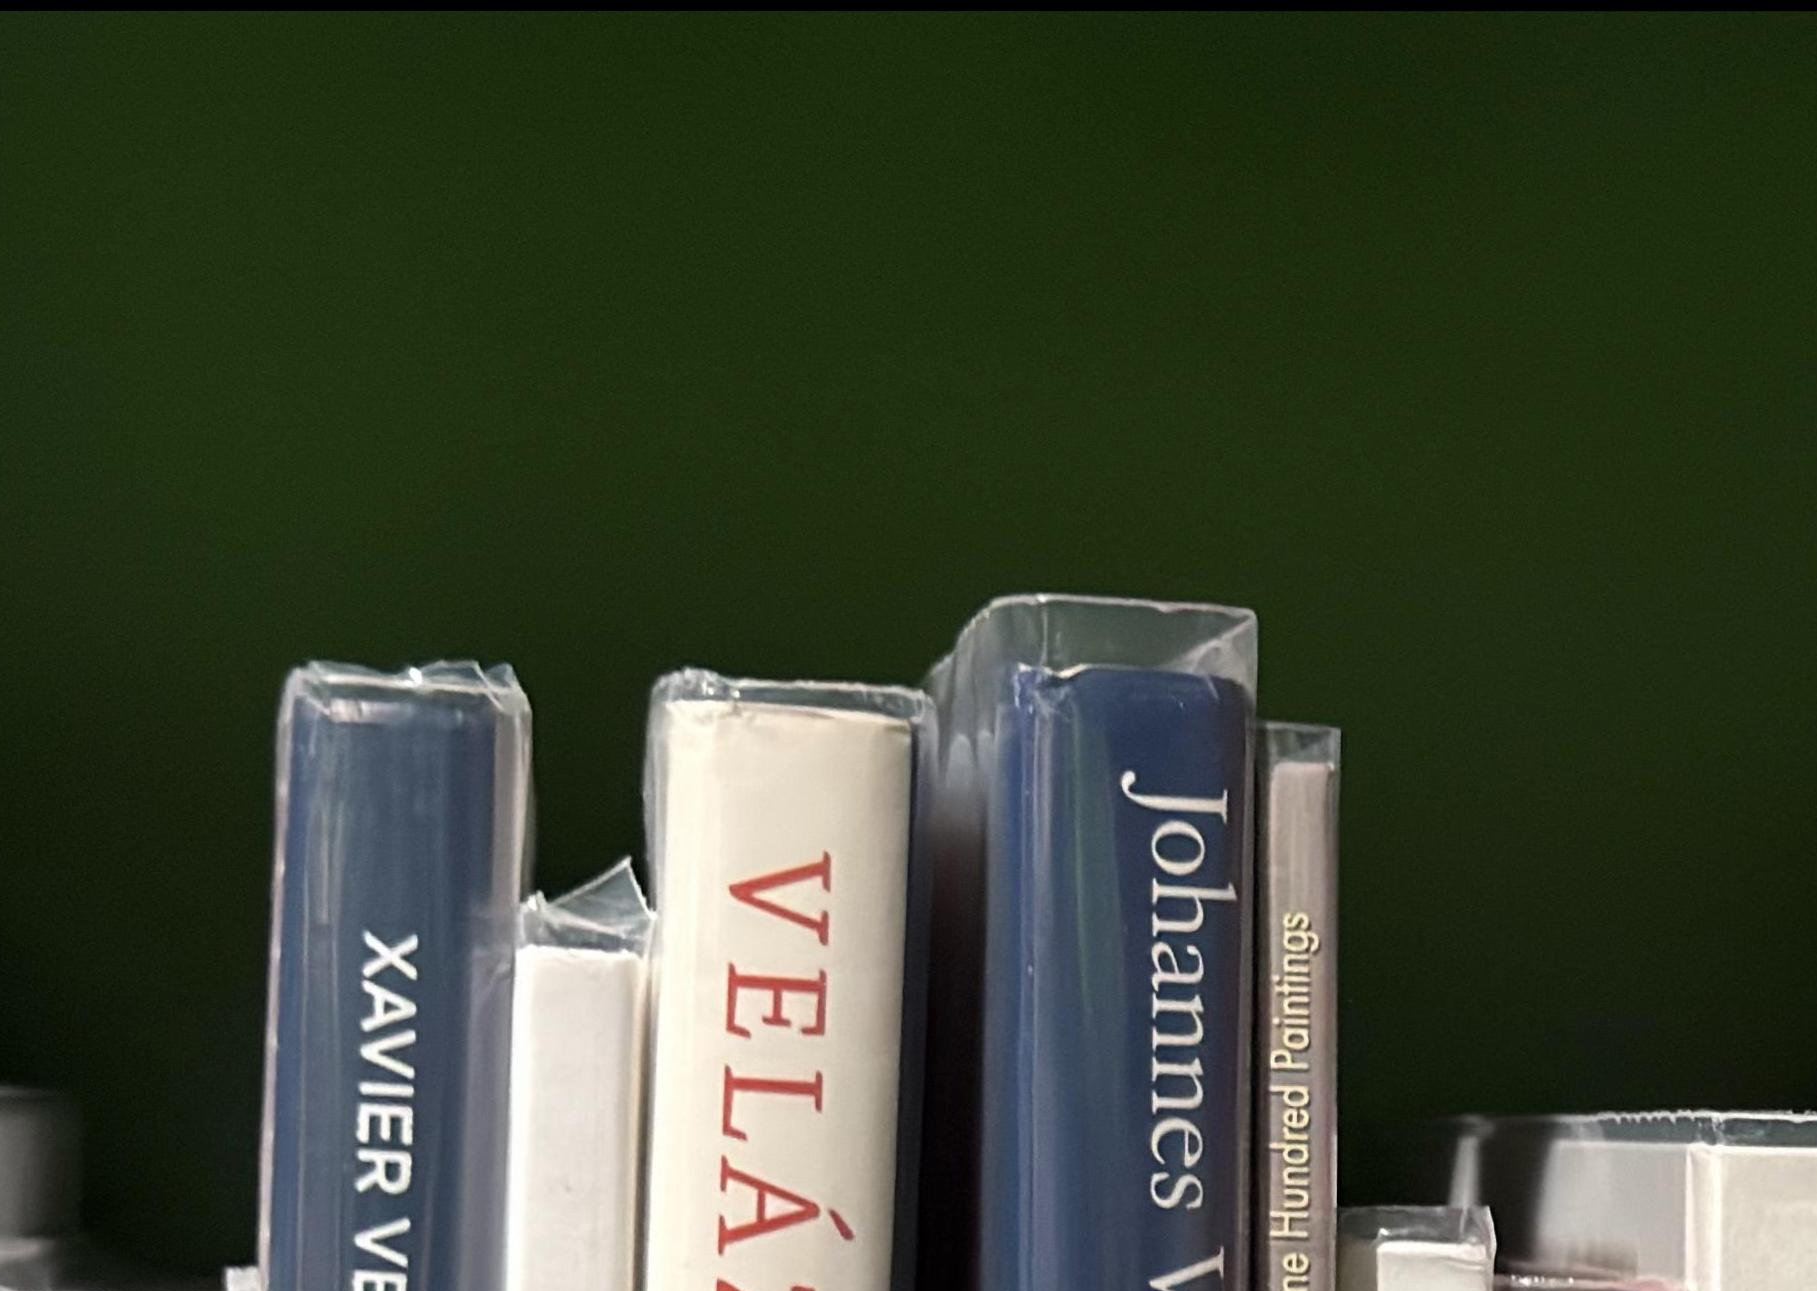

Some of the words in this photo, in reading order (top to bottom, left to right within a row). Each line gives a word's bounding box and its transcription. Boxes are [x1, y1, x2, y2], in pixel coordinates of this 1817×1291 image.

[355, 930, 419, 1194] XAVIER
[1121, 770, 1238, 1211] Johannes
[1270, 912, 1321, 1073] Paintings
[1270, 1080, 1310, 1238] Hundred
